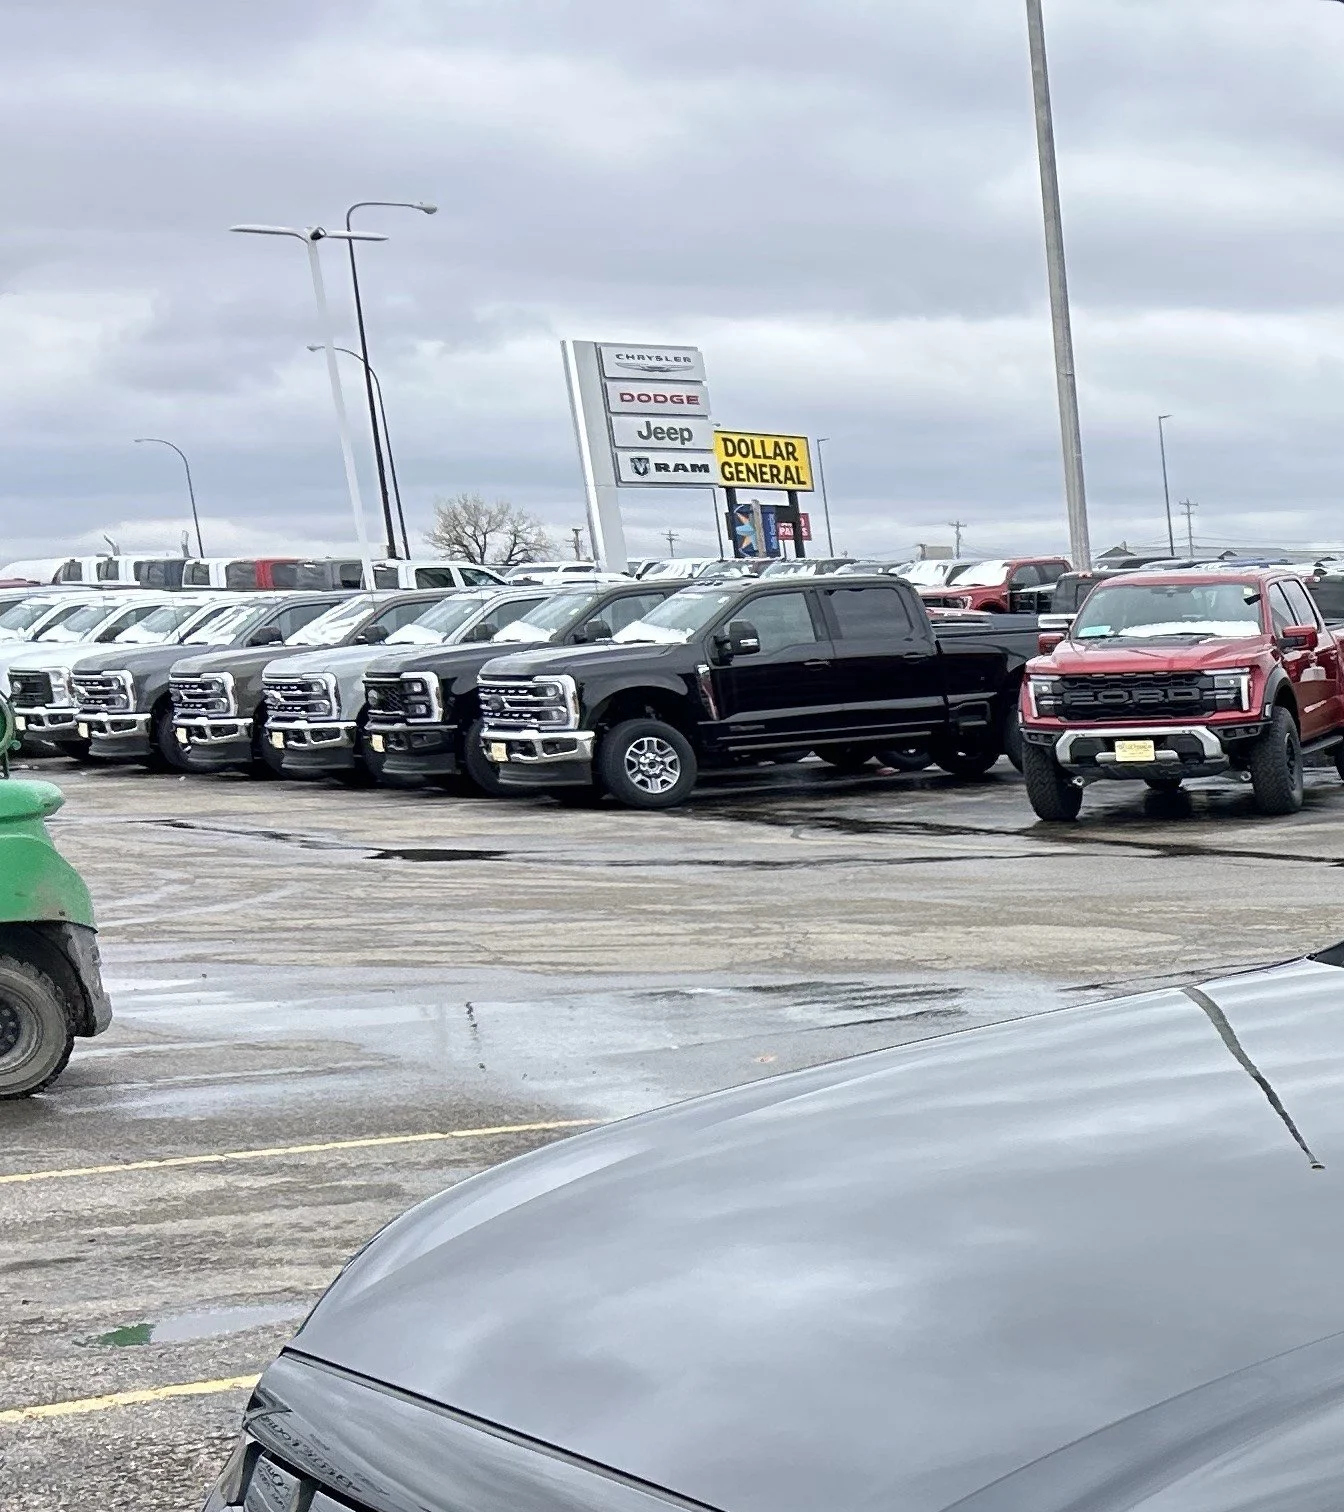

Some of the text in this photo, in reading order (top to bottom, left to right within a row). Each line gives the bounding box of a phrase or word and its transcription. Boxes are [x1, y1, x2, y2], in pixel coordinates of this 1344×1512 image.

[615, 353, 692, 363] CHRYSLER
[619, 392, 700, 405] DODGE
[637, 421, 694, 445] Jeep
[721, 437, 798, 462] DOLLAR
[654, 462, 710, 474] RAM
[720, 462, 806, 486] GENERAL
[1063, 688, 1200, 706] FORD
